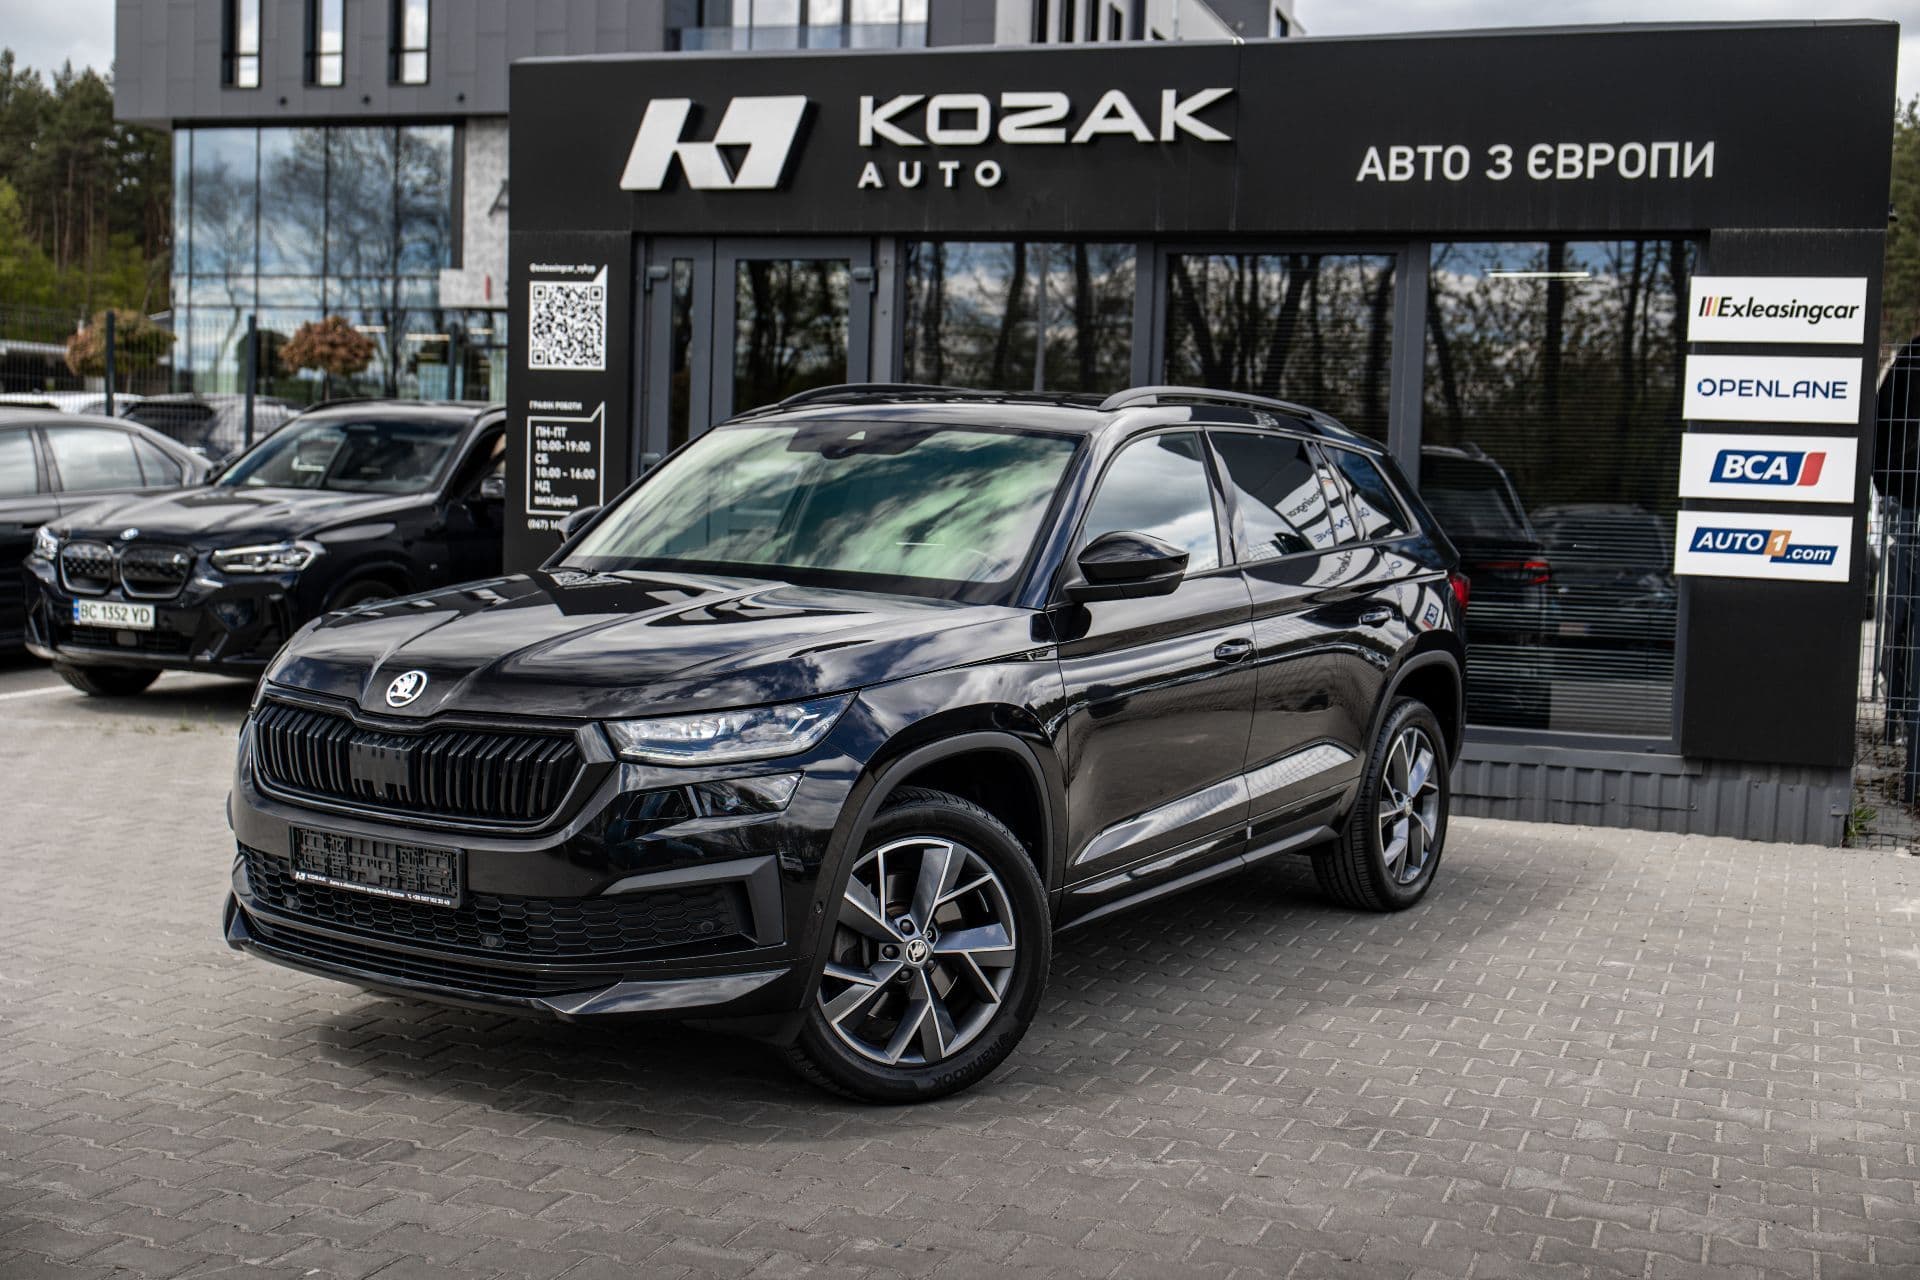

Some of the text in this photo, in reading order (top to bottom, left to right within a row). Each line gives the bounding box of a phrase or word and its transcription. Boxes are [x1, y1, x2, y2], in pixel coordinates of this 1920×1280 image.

[859, 87, 1235, 147] KOZAK
[1355, 140, 1716, 182] АВТО З ЄВРОПИ
[857, 160, 1002, 189] AUTO
[1717, 296, 1860, 325] Exleasingcar
[1697, 378, 1849, 400] OPENLANE
[535, 425, 567, 438] ПН-ПТ
[536, 439, 592, 453] 10:00-19:00
[536, 466, 561, 479] 10:00
[570, 467, 597, 480] 16:00
[1721, 454, 1789, 482] BCA
[81, 603, 150, 623] BC 1352 YD
